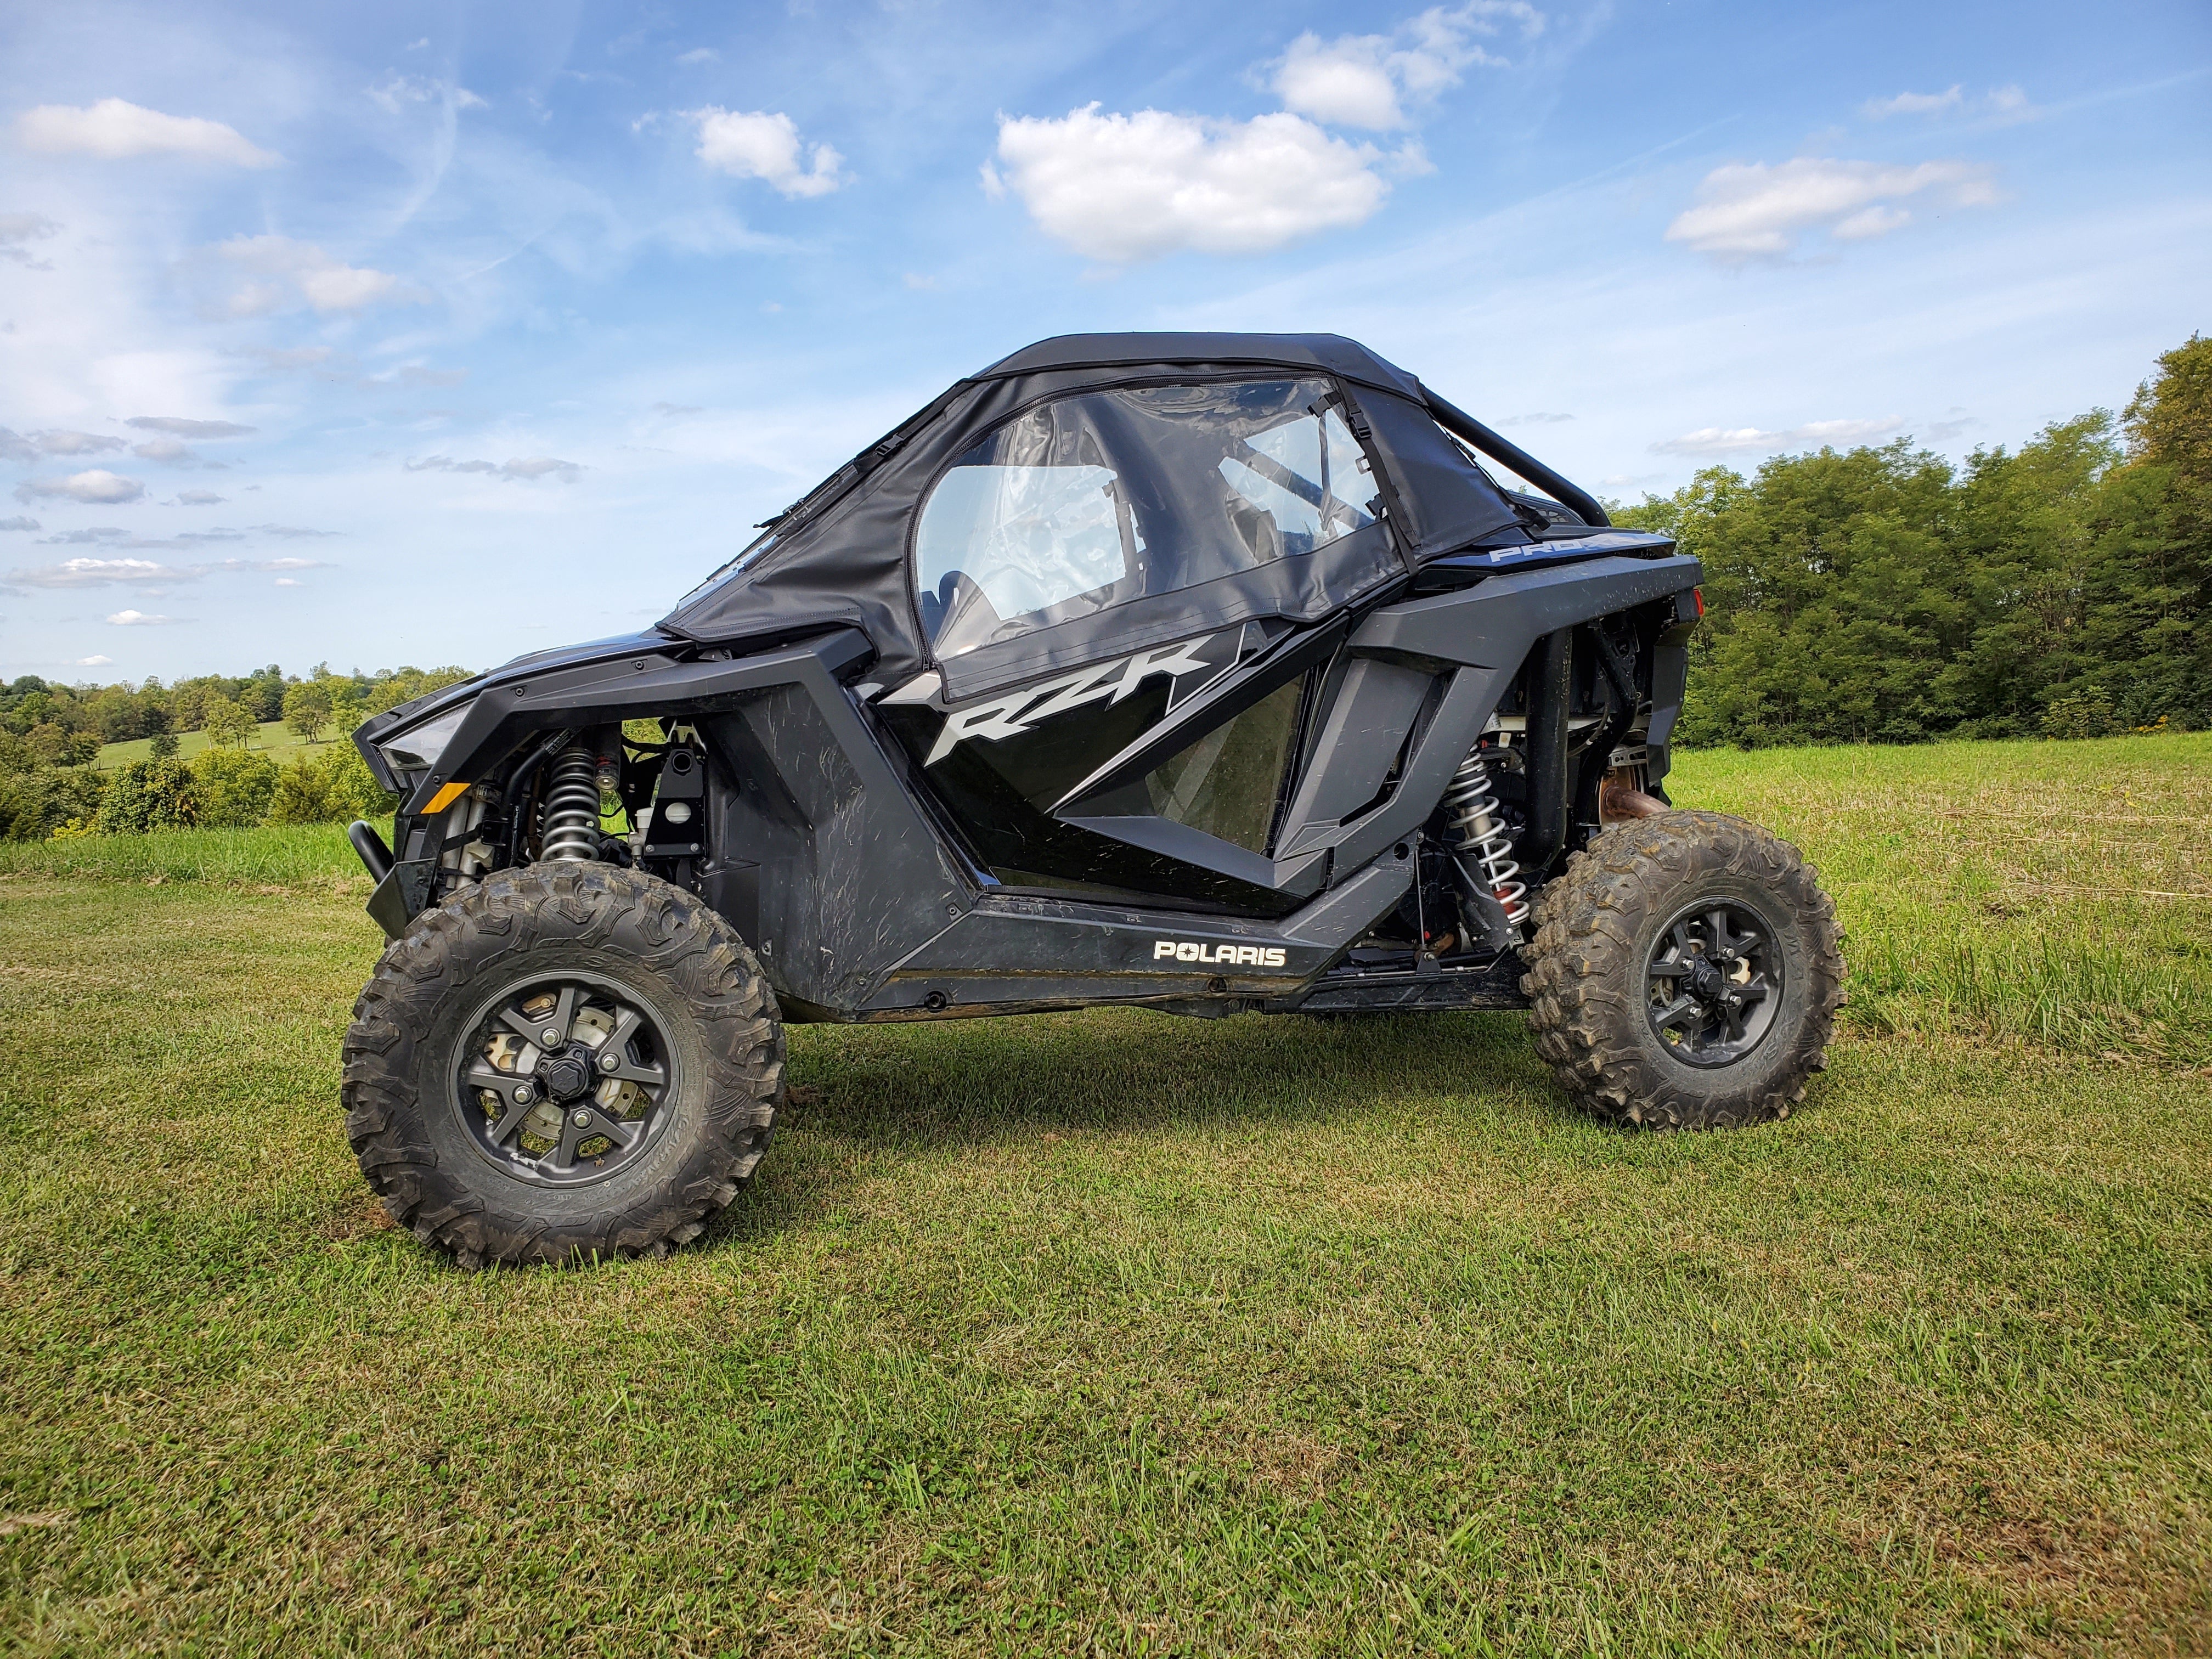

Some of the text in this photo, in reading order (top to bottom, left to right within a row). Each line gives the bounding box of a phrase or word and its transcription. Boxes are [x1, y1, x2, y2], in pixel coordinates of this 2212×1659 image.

[1488, 540, 1583, 563] PRO
[923, 633, 1216, 768] RZR
[1154, 941, 1285, 967] POLARIS
